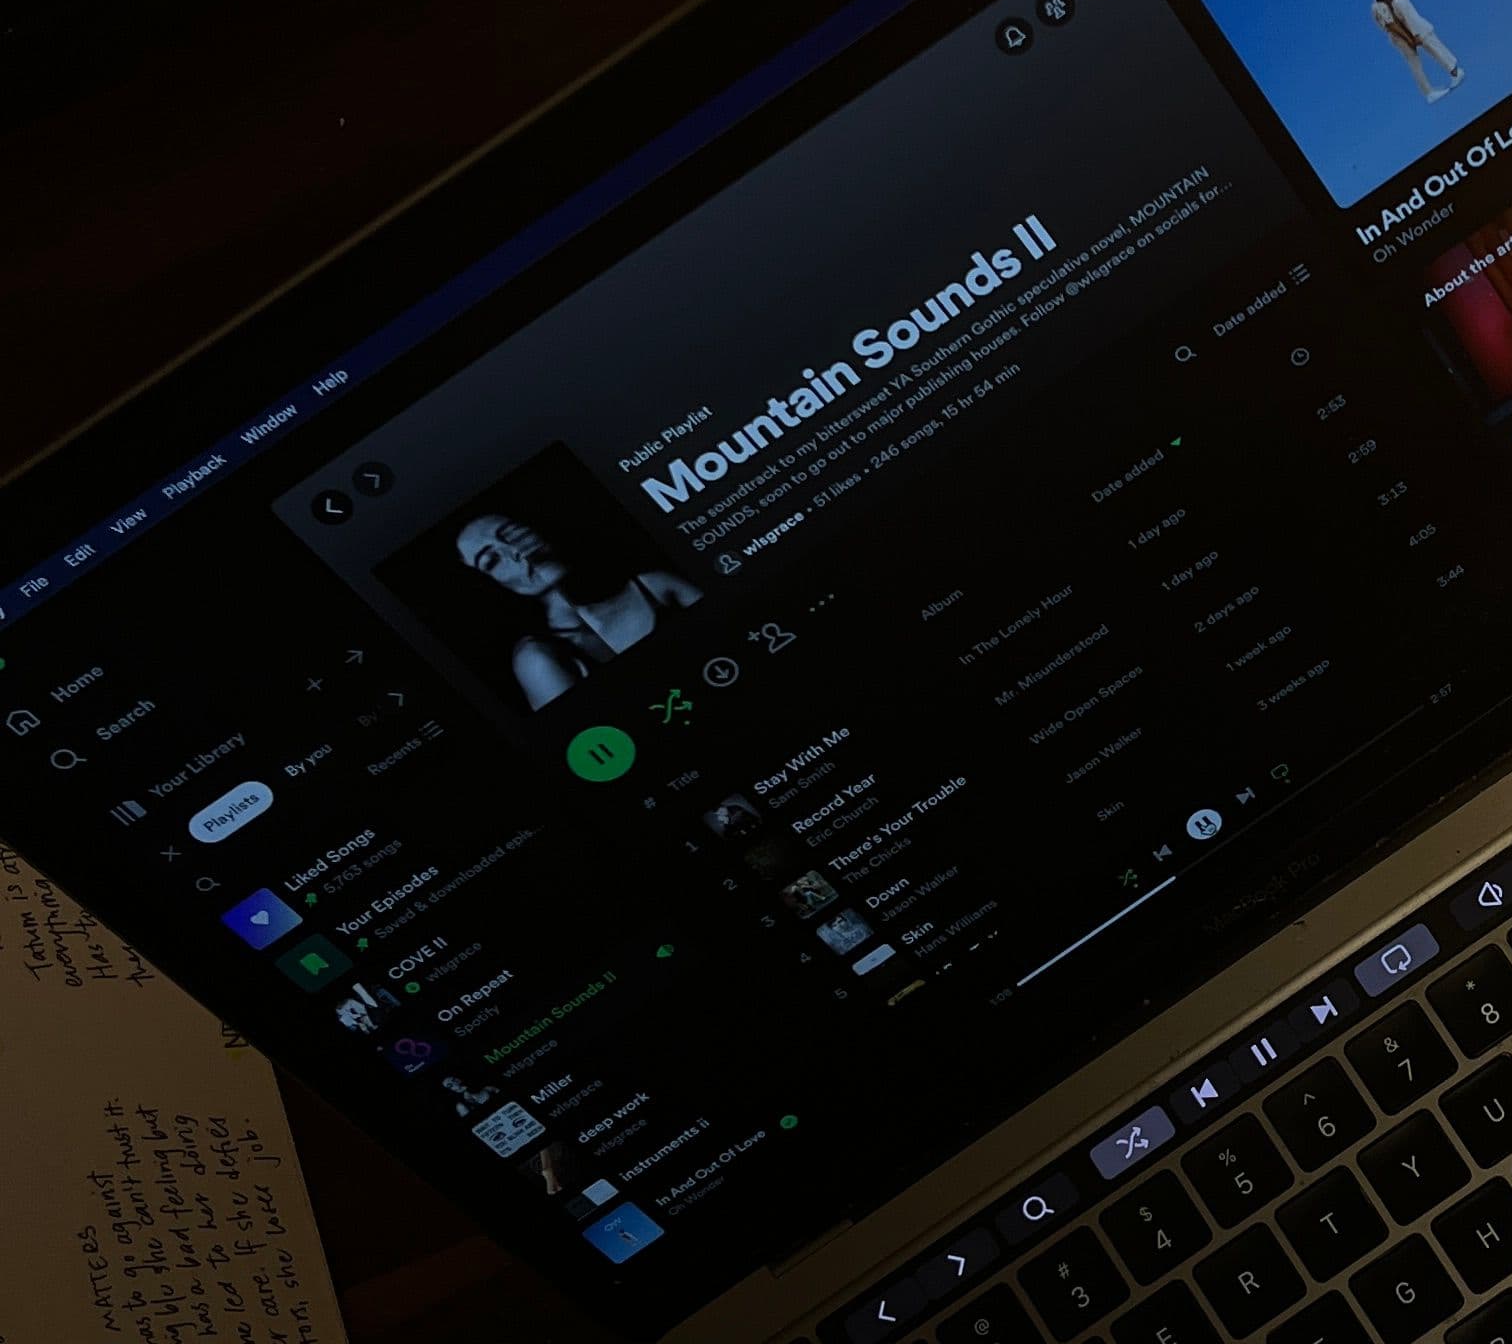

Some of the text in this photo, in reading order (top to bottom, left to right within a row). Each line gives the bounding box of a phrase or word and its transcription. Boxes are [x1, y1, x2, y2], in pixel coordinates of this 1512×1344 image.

[1355, 223, 1382, 245] In
[1380, 186, 1426, 232] And
[1423, 160, 1469, 197] Out
[1465, 135, 1496, 167] Of
[1372, 201, 1454, 263] Oh Wonder
[1212, 280, 1287, 337] Date added
[1424, 268, 1473, 308] About
[1468, 253, 1495, 274] the
[639, 213, 1057, 513] Mountain Sounds II
[676, 164, 1210, 535] The soundtrack bittersweet YA Southern Gothic speculative novel, MOUNTAIN
[691, 504, 760, 551] SOUNDS,
[758, 481, 792, 507] soon
[866, 402, 904, 434] major
[904, 358, 974, 410] publishing
[968, 325, 1022, 362] houses.
[1019, 292, 1065, 327] Follow
[1154, 200, 1200, 235] socials
[617, 405, 713, 473] Public Playlist
[828, 472, 862, 497] likes
[869, 443, 900, 469] 246
[972, 378, 994, 398] 54
[994, 363, 1021, 385] min
[19, 369, 349, 598] File Edit View Playback Window Help
[920, 588, 964, 621] Album
[1039, 584, 1073, 610] Hour
[49, 666, 104, 703] Home
[1016, 622, 1110, 691] Misunderstood
[95, 699, 156, 741] Search
[147, 731, 246, 798] Your Library
[202, 743, 333, 833] Playlists By you
[365, 737, 423, 776] Recents
[753, 727, 850, 795] Stay With Me
[790, 773, 876, 834] Record Year
[827, 776, 967, 871] There's Your Trouble
[283, 828, 376, 892] Liked Songs
[335, 865, 440, 935] Your Episodes
[864, 877, 910, 909] Down
[387, 935, 449, 979] COVE II
[900, 921, 934, 945] Skin
[437, 968, 515, 1022] On Repeat
[482, 1016, 553, 1064] Mountain
[550, 980, 605, 1019] Sounds
[530, 1073, 573, 1104] Miller
[577, 1116, 614, 1144] deep
[613, 1091, 651, 1119] work
[618, 1125, 700, 1182] instruments
[85, 1163, 141, 1245] against
[1236, 1270, 1261, 1295] R
[1319, 1211, 1339, 1234] T
[1400, 1154, 1421, 1178] Y
[1482, 1097, 1506, 1123] U
[78, 1224, 121, 1331] MATTERS
